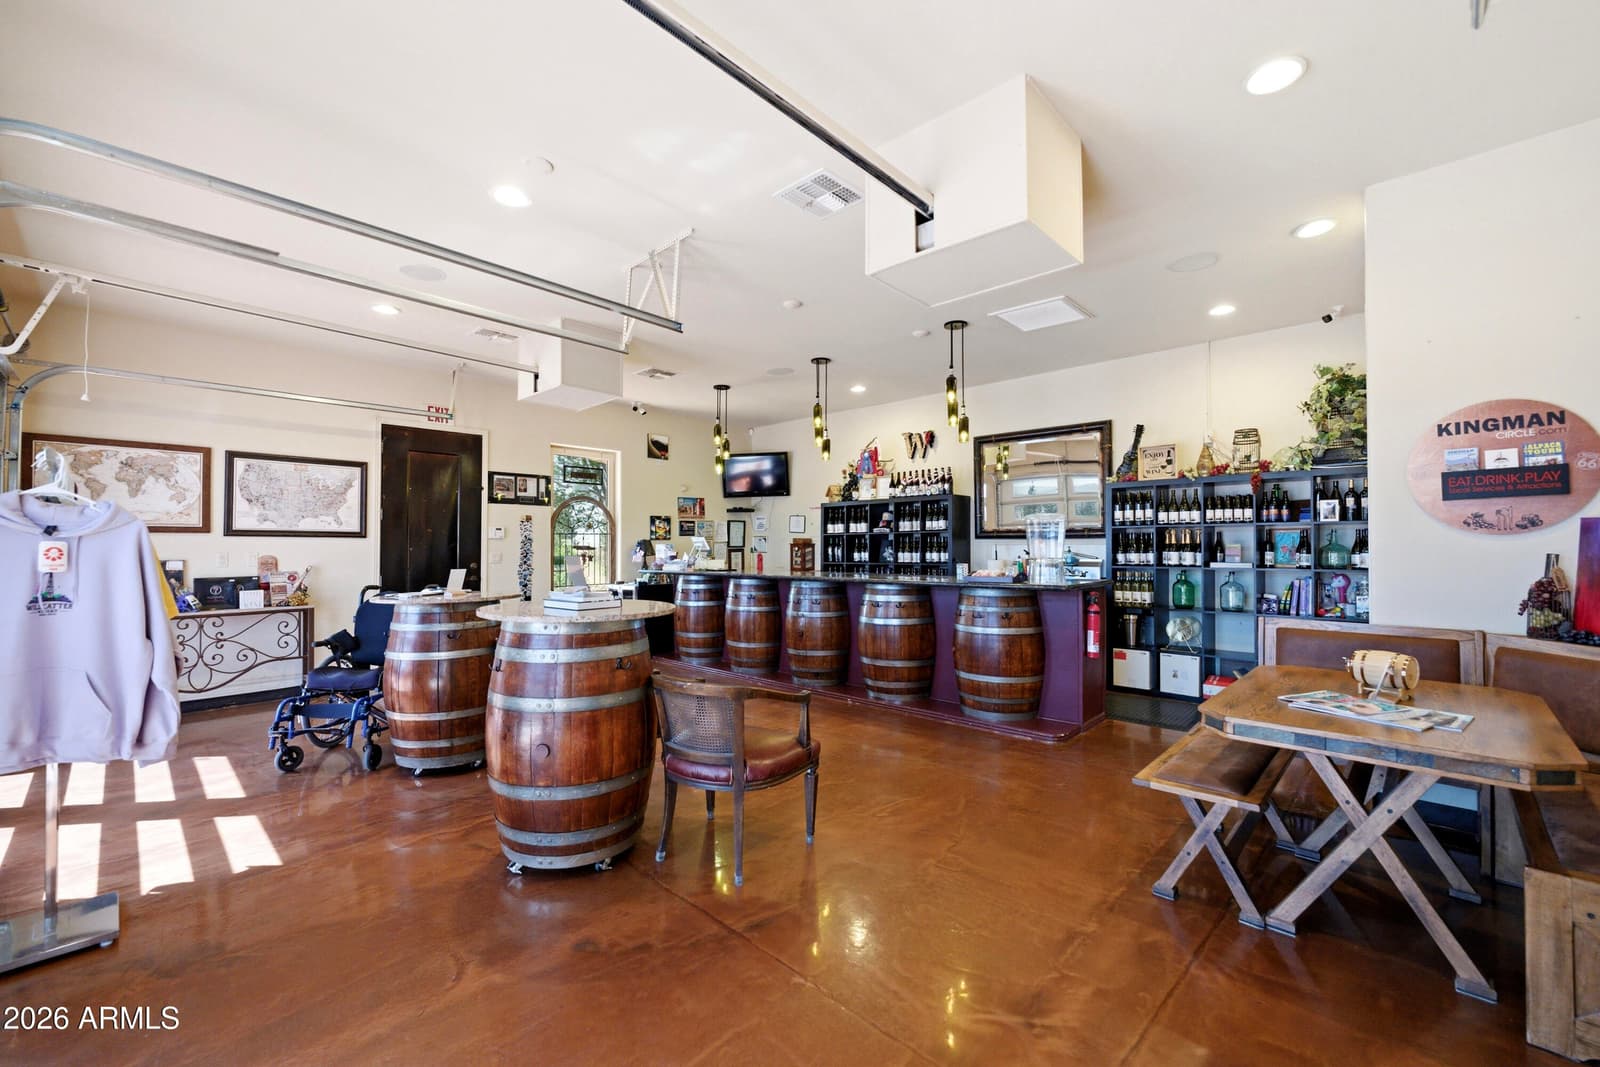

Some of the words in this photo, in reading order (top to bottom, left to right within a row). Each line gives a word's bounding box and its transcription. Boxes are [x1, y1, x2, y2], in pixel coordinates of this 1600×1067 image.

[427, 405, 449, 423] EXIT
[1437, 410, 1566, 437] KINGMAN
[1527, 441, 1562, 450] ALPACA
[1144, 451, 1164, 459] ENJOY
[1577, 458, 1597, 469] 66
